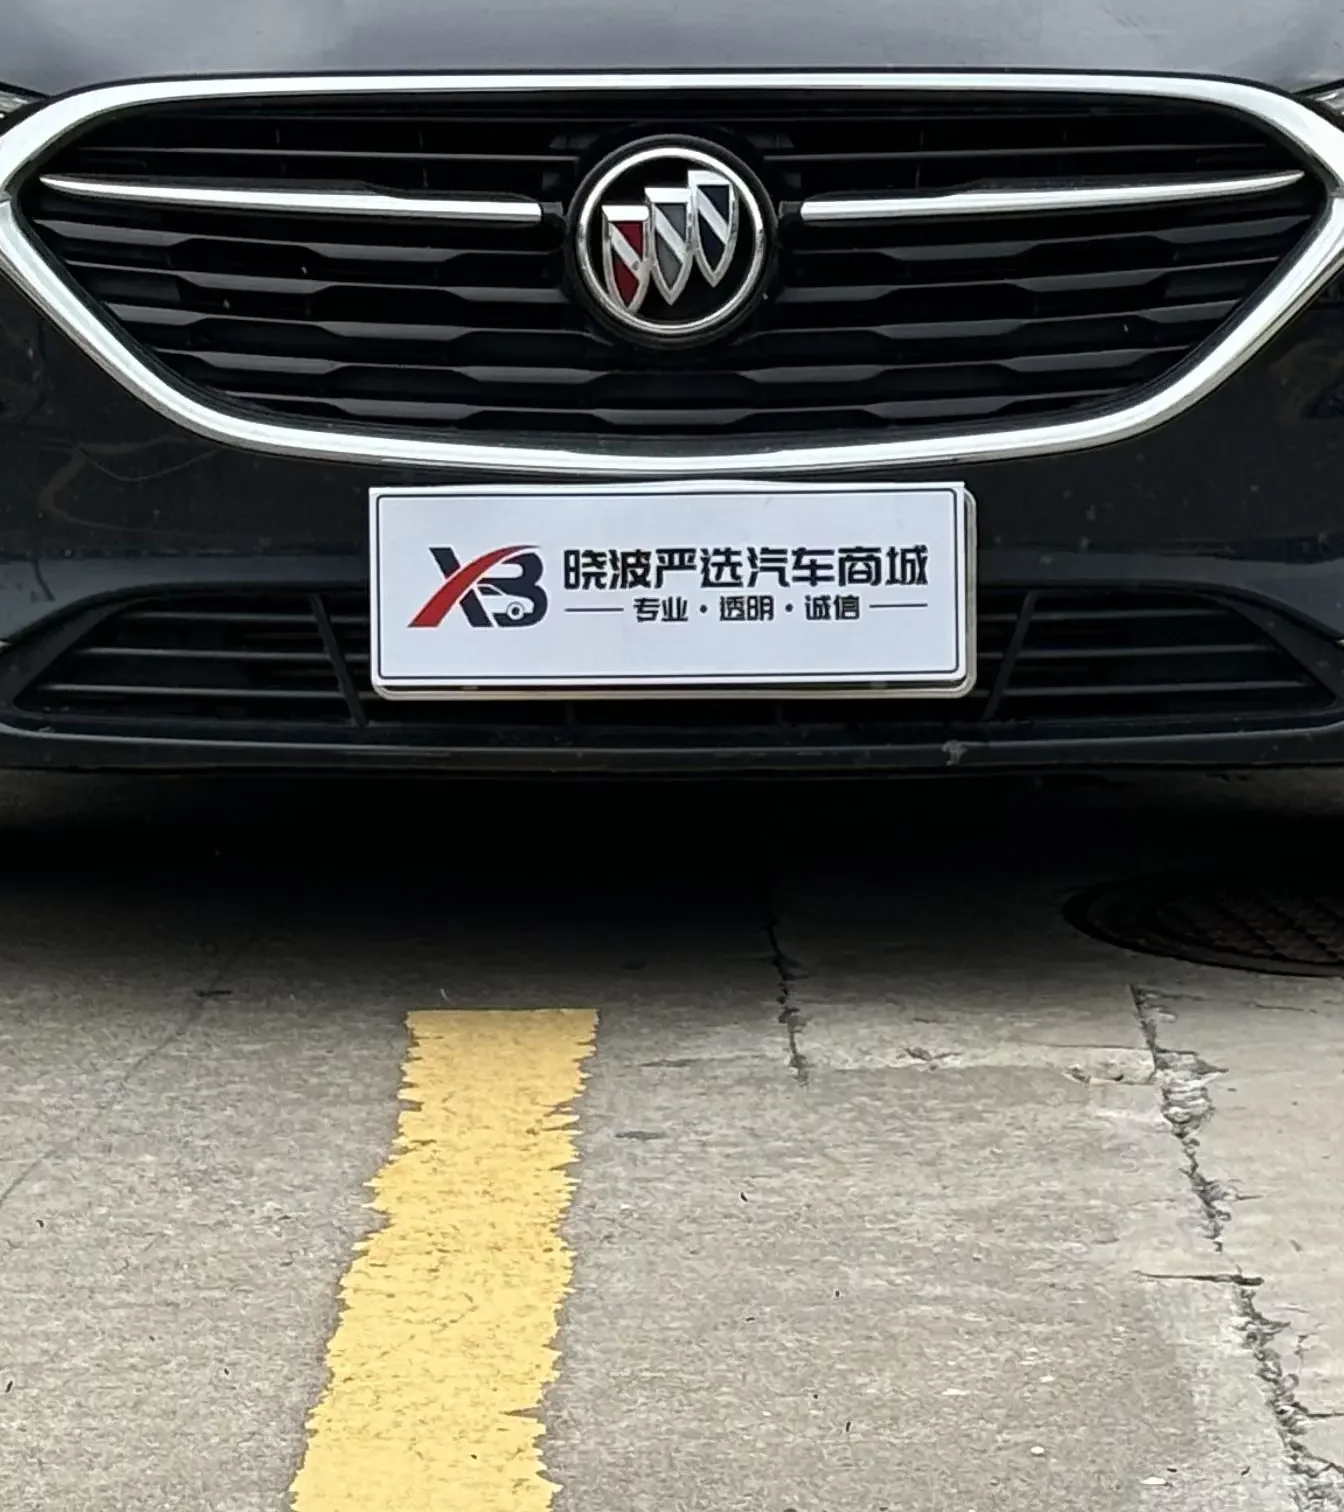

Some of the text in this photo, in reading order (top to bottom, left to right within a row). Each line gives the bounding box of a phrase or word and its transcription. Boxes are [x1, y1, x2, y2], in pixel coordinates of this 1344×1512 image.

[563, 544, 929, 590] 晓波严选汽车商城
